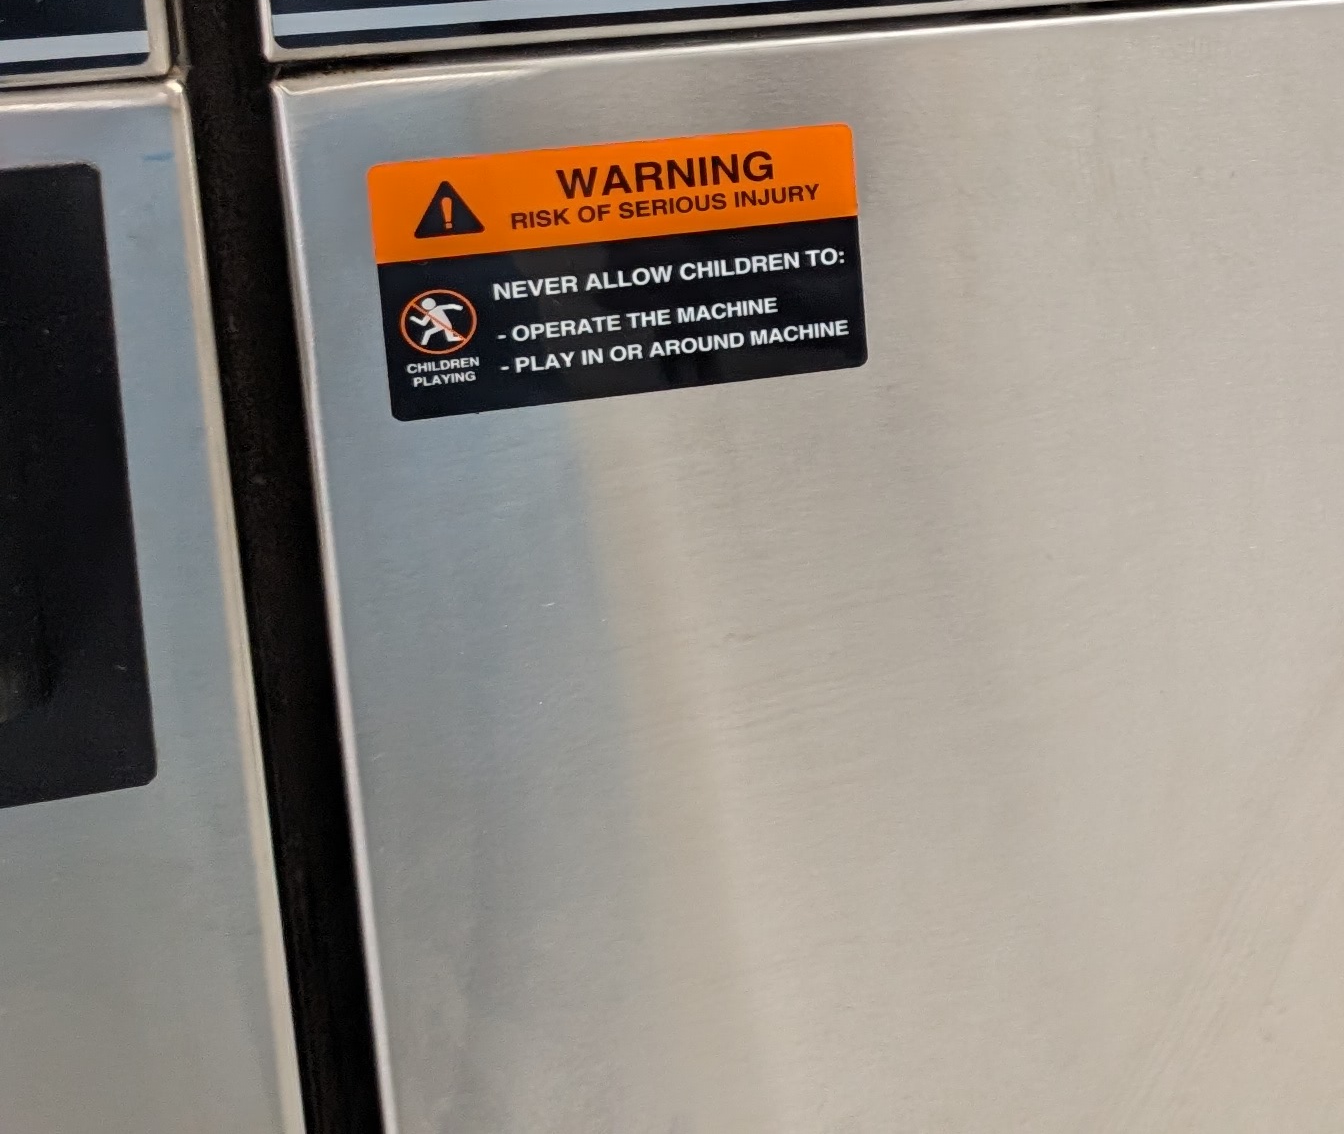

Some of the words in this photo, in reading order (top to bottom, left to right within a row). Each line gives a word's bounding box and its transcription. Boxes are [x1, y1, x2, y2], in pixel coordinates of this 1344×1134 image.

[555, 149, 775, 200] WARNING
[510, 206, 571, 232] RISK
[577, 203, 612, 223] OF
[618, 192, 727, 221] SERIOUS
[733, 182, 820, 210] INJURY
[492, 274, 579, 302] NEVER
[585, 263, 673, 291] ALLOW
[679, 252, 801, 283] CHILDREN
[805, 246, 846, 269] TO:
[511, 314, 622, 343] OPERATE
[626, 309, 671, 332] THE
[677, 296, 779, 326] MACHINE
[406, 357, 480, 375] CHILDREN
[515, 349, 576, 374] PLAY
[580, 347, 604, 367] IN
[609, 341, 644, 364] OR
[649, 331, 745, 359] AROUND
[750, 319, 849, 347] MACHINE
[412, 370, 477, 388] PLAYING
